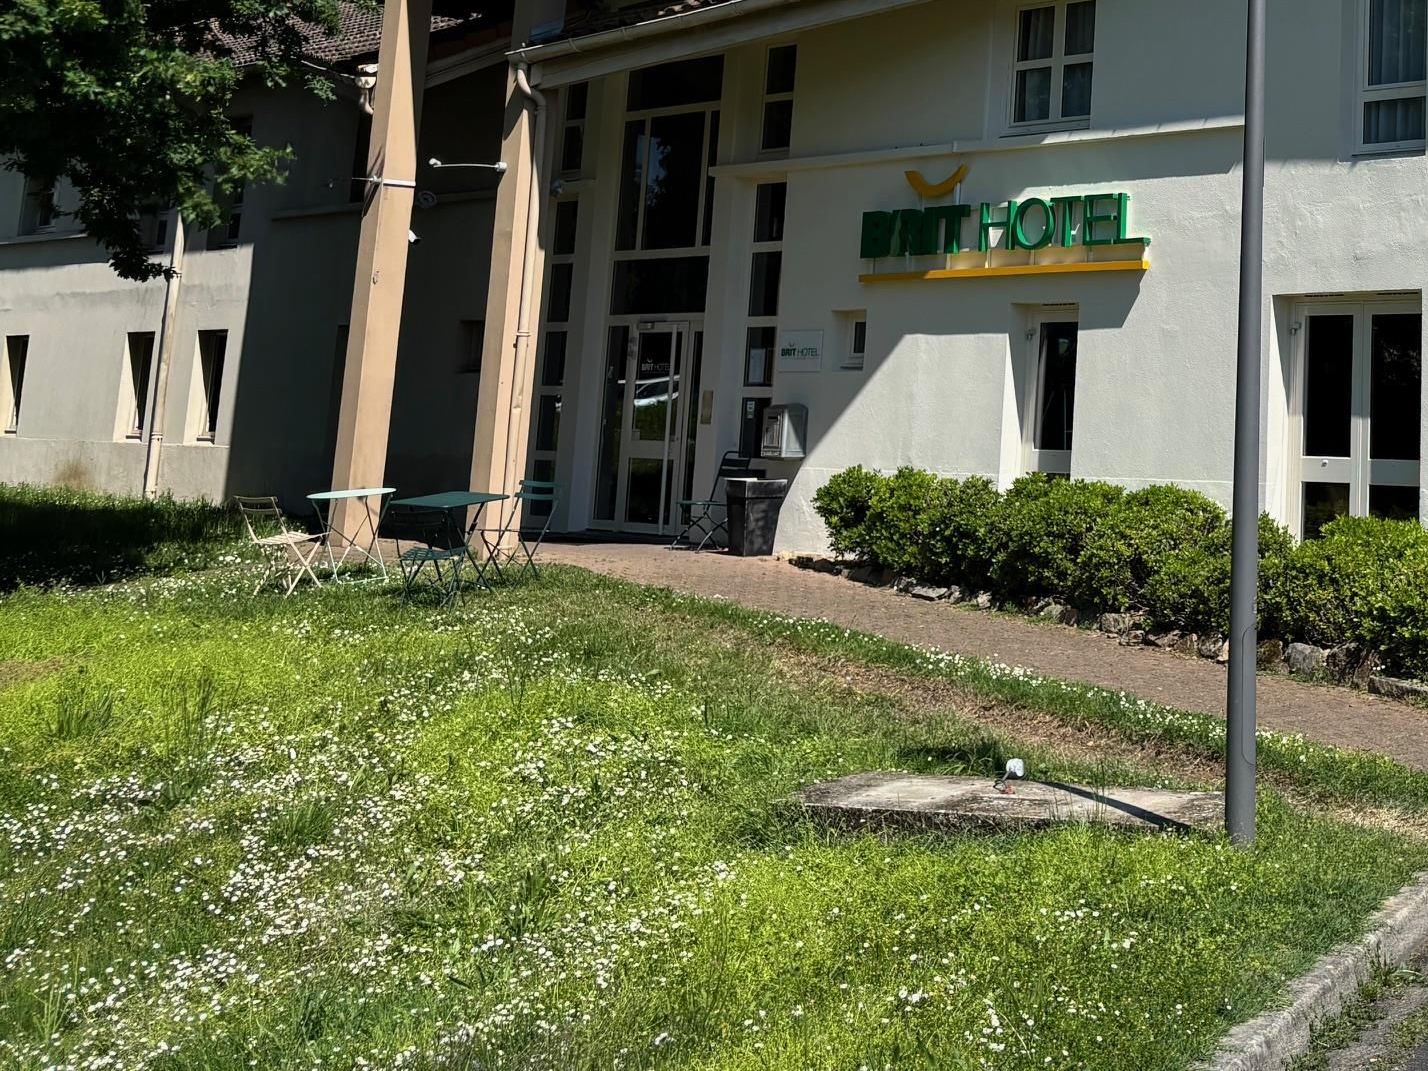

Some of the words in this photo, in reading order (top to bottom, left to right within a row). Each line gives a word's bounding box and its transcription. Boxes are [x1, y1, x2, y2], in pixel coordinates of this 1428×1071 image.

[860, 204, 971, 258] BRIT
[979, 193, 1151, 250] HOTEL
[781, 347, 796, 357] BRIT
[797, 347, 820, 357] HOTEL
